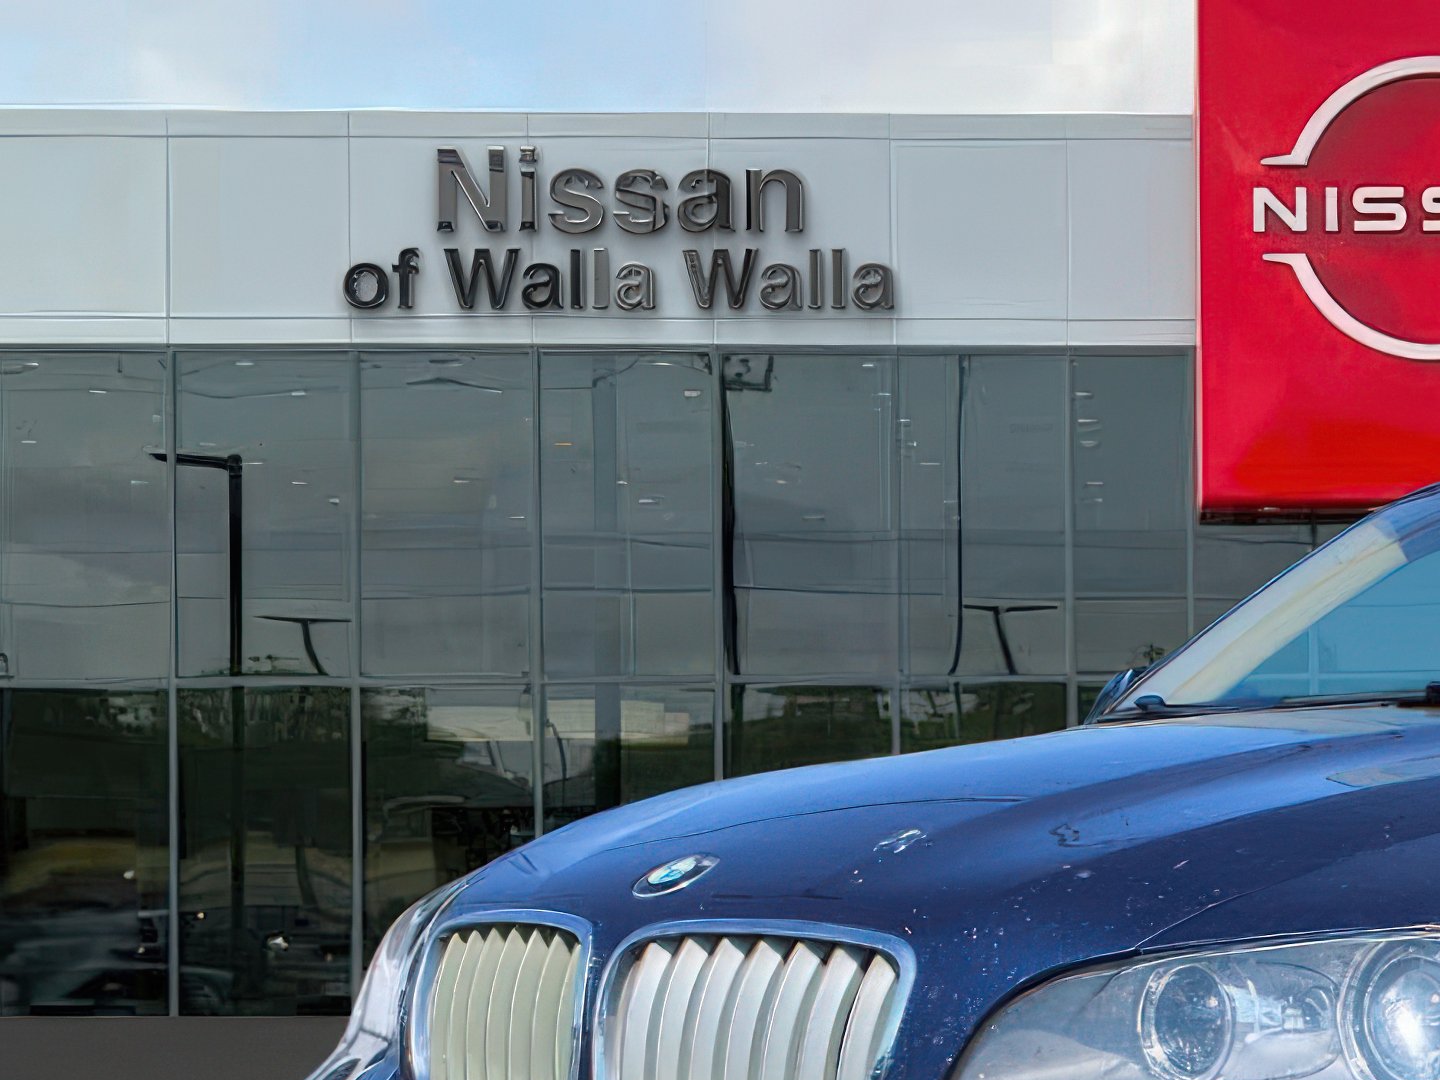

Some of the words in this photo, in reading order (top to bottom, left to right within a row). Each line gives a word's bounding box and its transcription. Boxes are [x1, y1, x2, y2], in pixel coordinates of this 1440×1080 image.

[436, 145, 805, 234] Nissan
[342, 247, 421, 310] of
[443, 247, 657, 311] Walla
[682, 247, 895, 311] Walla
